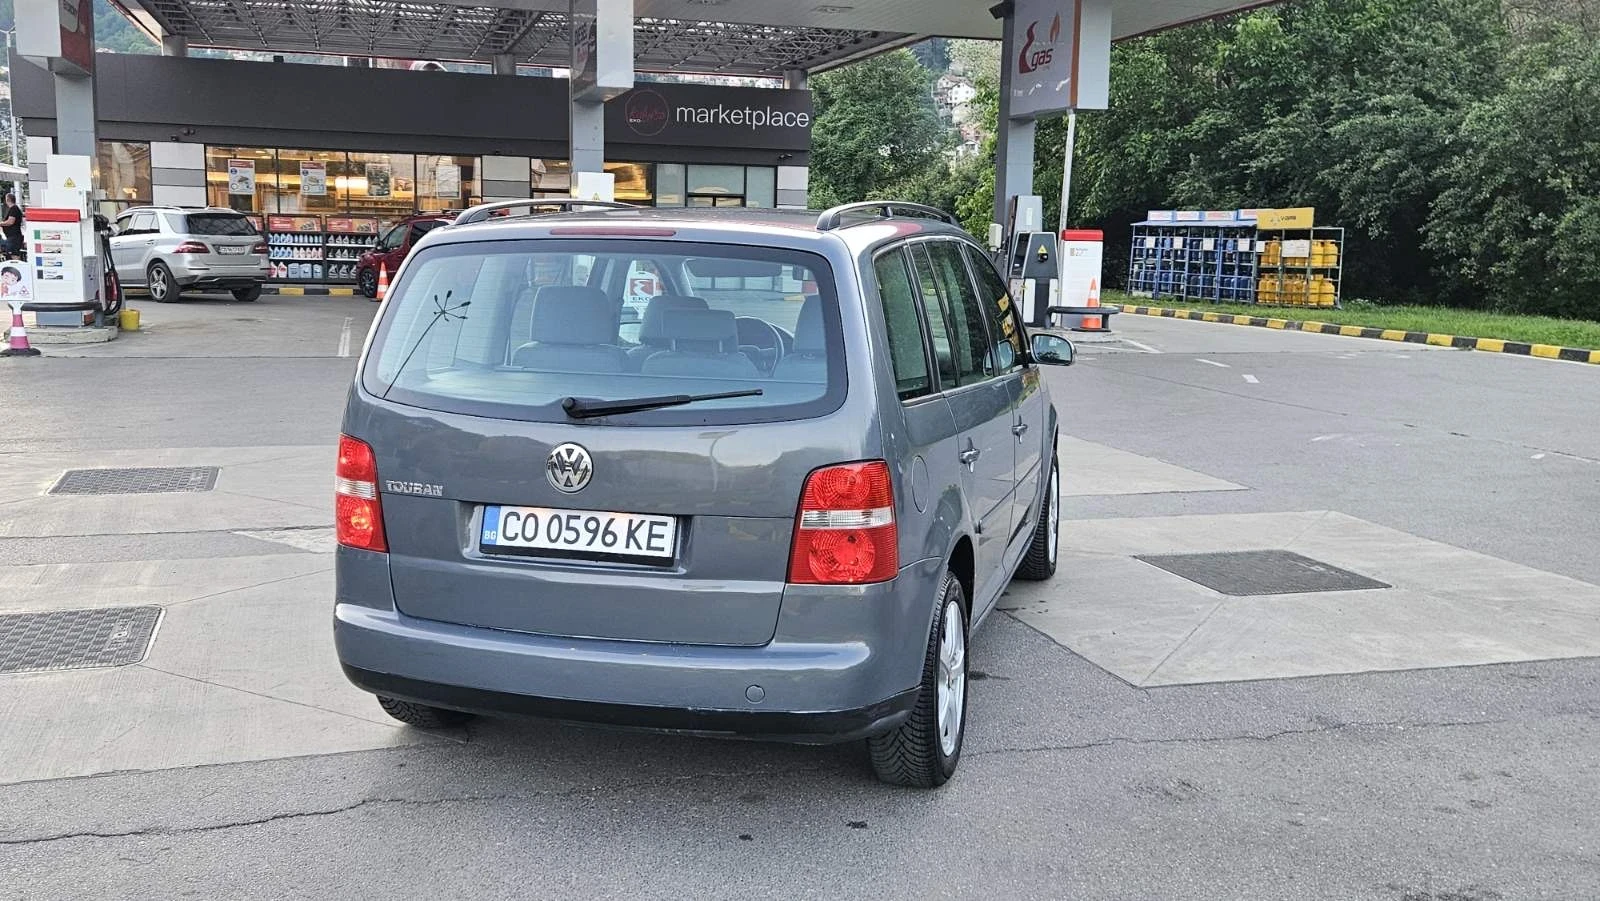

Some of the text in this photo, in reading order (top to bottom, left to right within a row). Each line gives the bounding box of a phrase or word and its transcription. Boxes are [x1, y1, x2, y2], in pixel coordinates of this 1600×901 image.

[676, 104, 810, 130] marketplace
[385, 480, 444, 497] TOURAN
[484, 531, 497, 540] BG
[502, 511, 668, 552] CO 0596 KE
